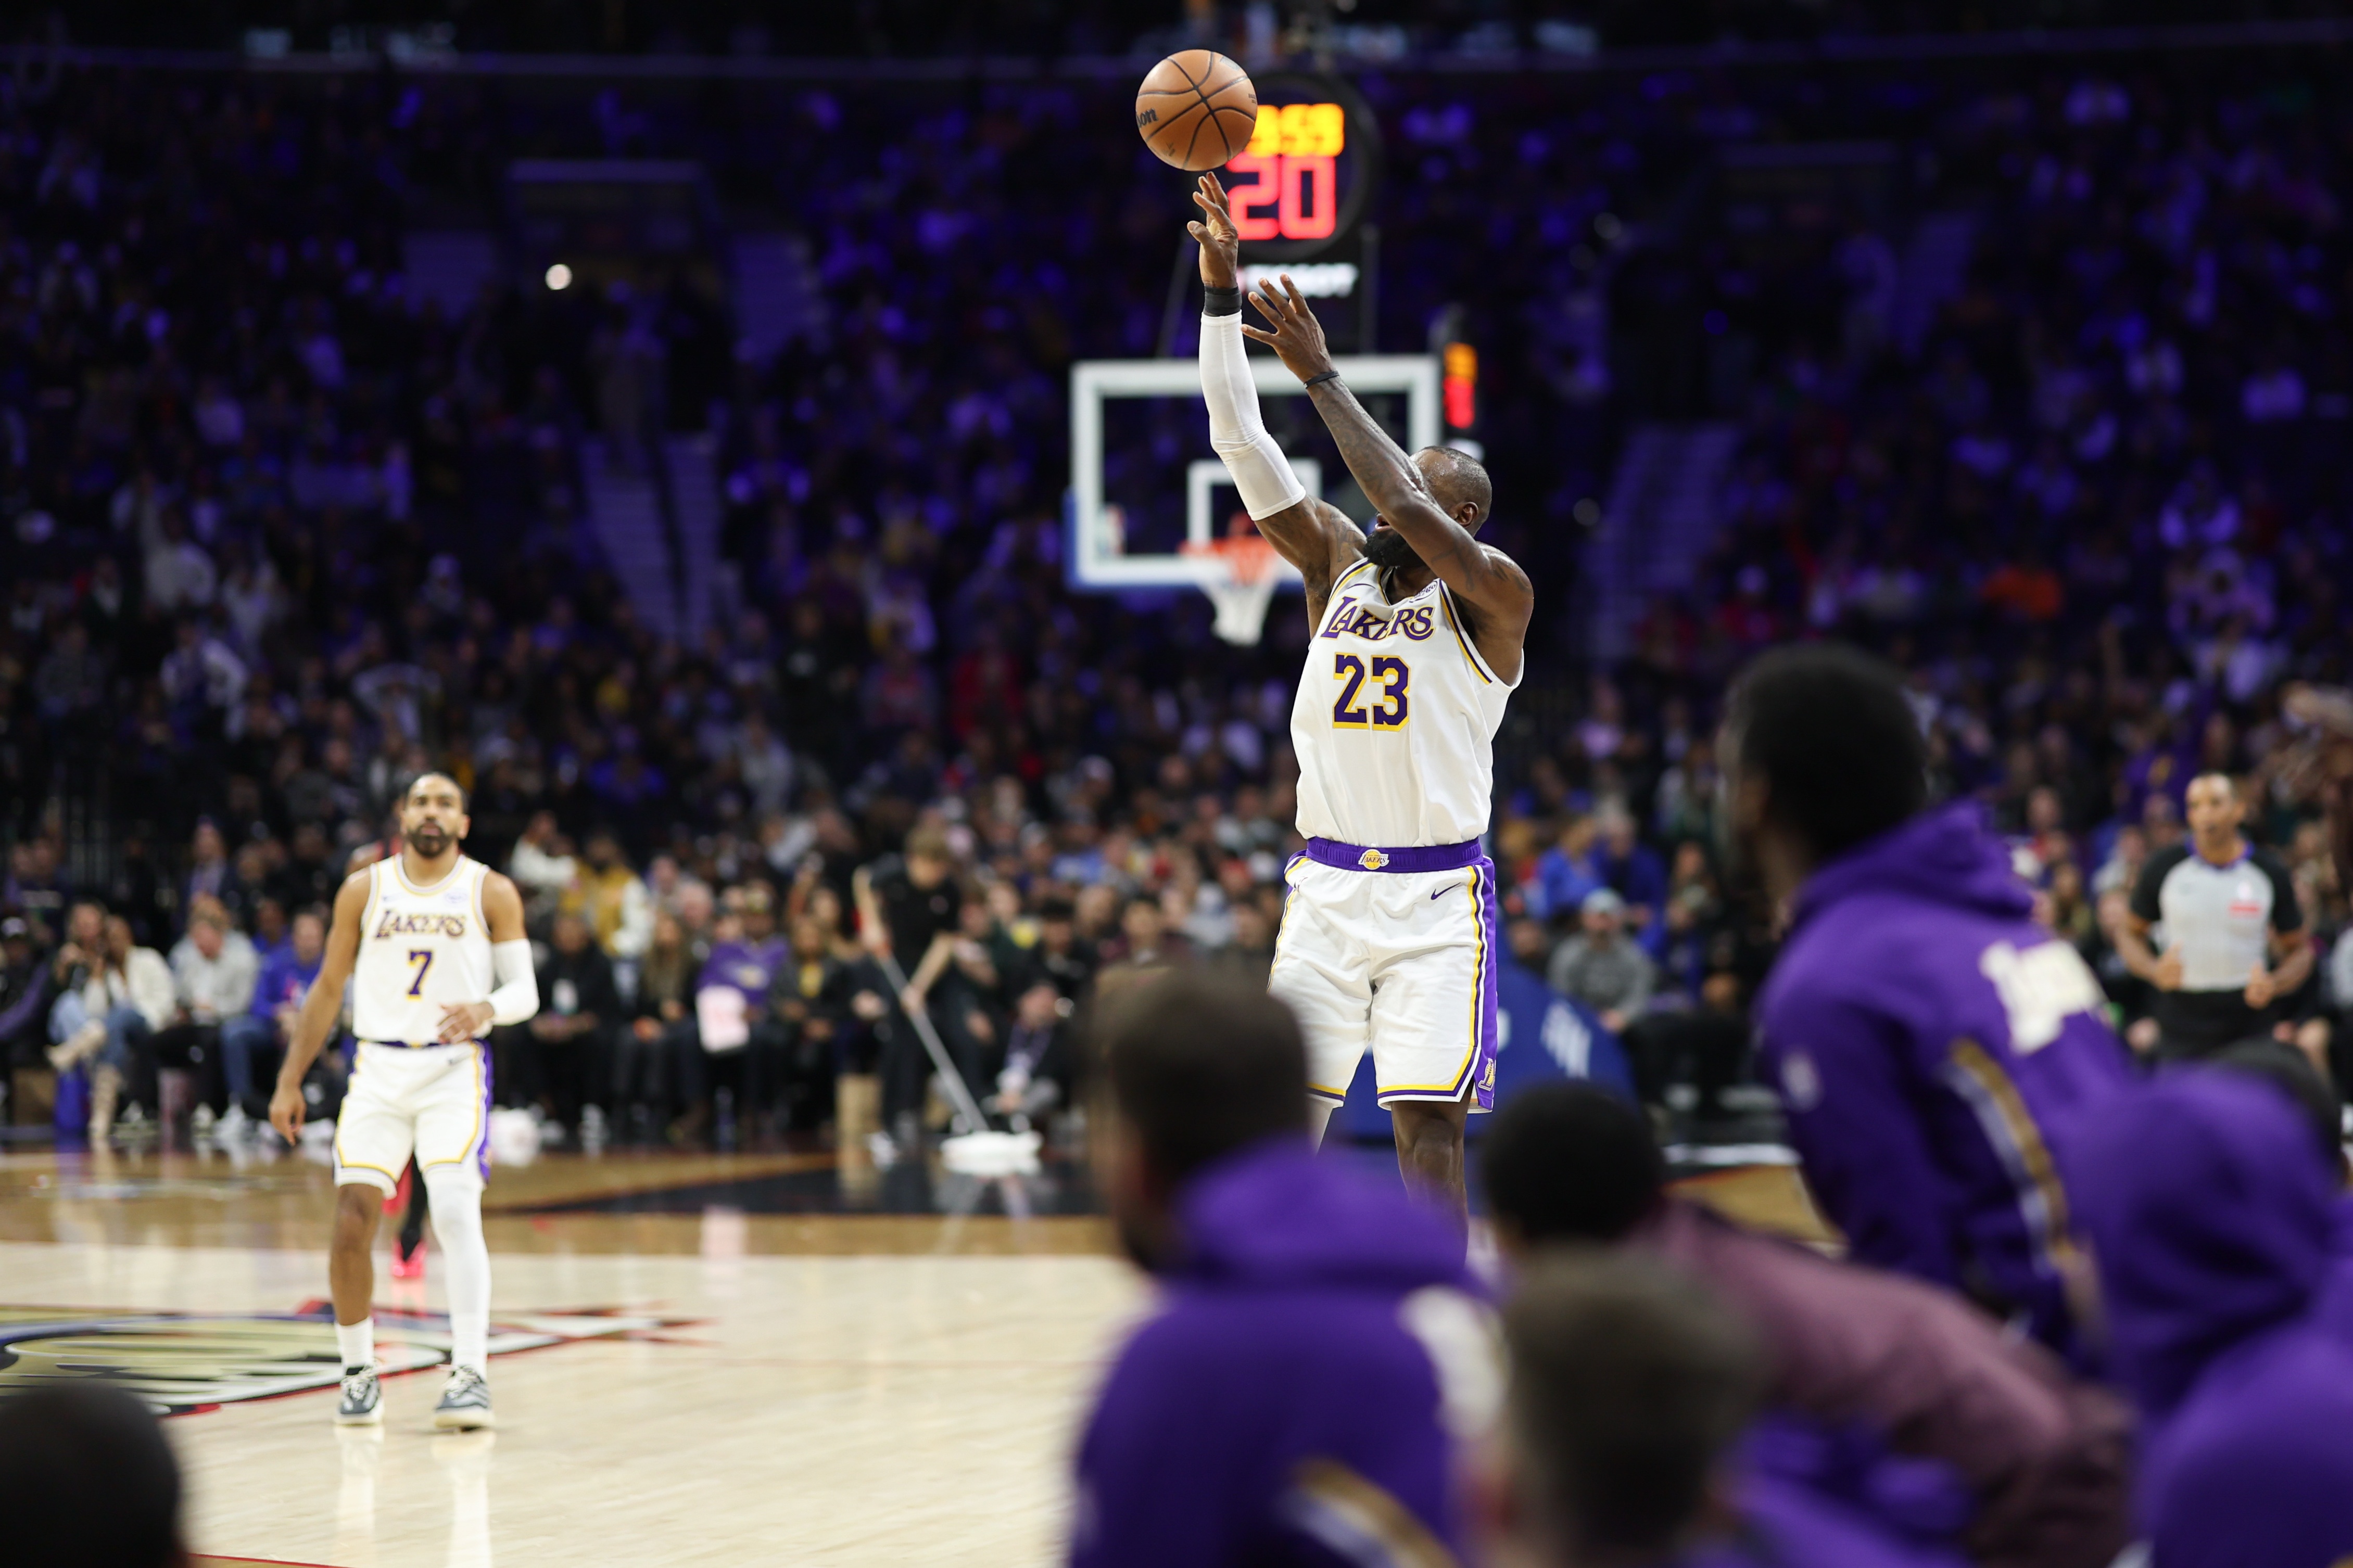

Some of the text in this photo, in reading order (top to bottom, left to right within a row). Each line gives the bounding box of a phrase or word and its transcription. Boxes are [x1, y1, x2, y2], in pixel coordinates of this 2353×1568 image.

[1226, 153, 1336, 240] 20
[1332, 652, 1411, 732] 23
[1360, 854, 1388, 865] LAKERS
[375, 909, 467, 939] LAKERS
[407, 949, 434, 1000] 7
